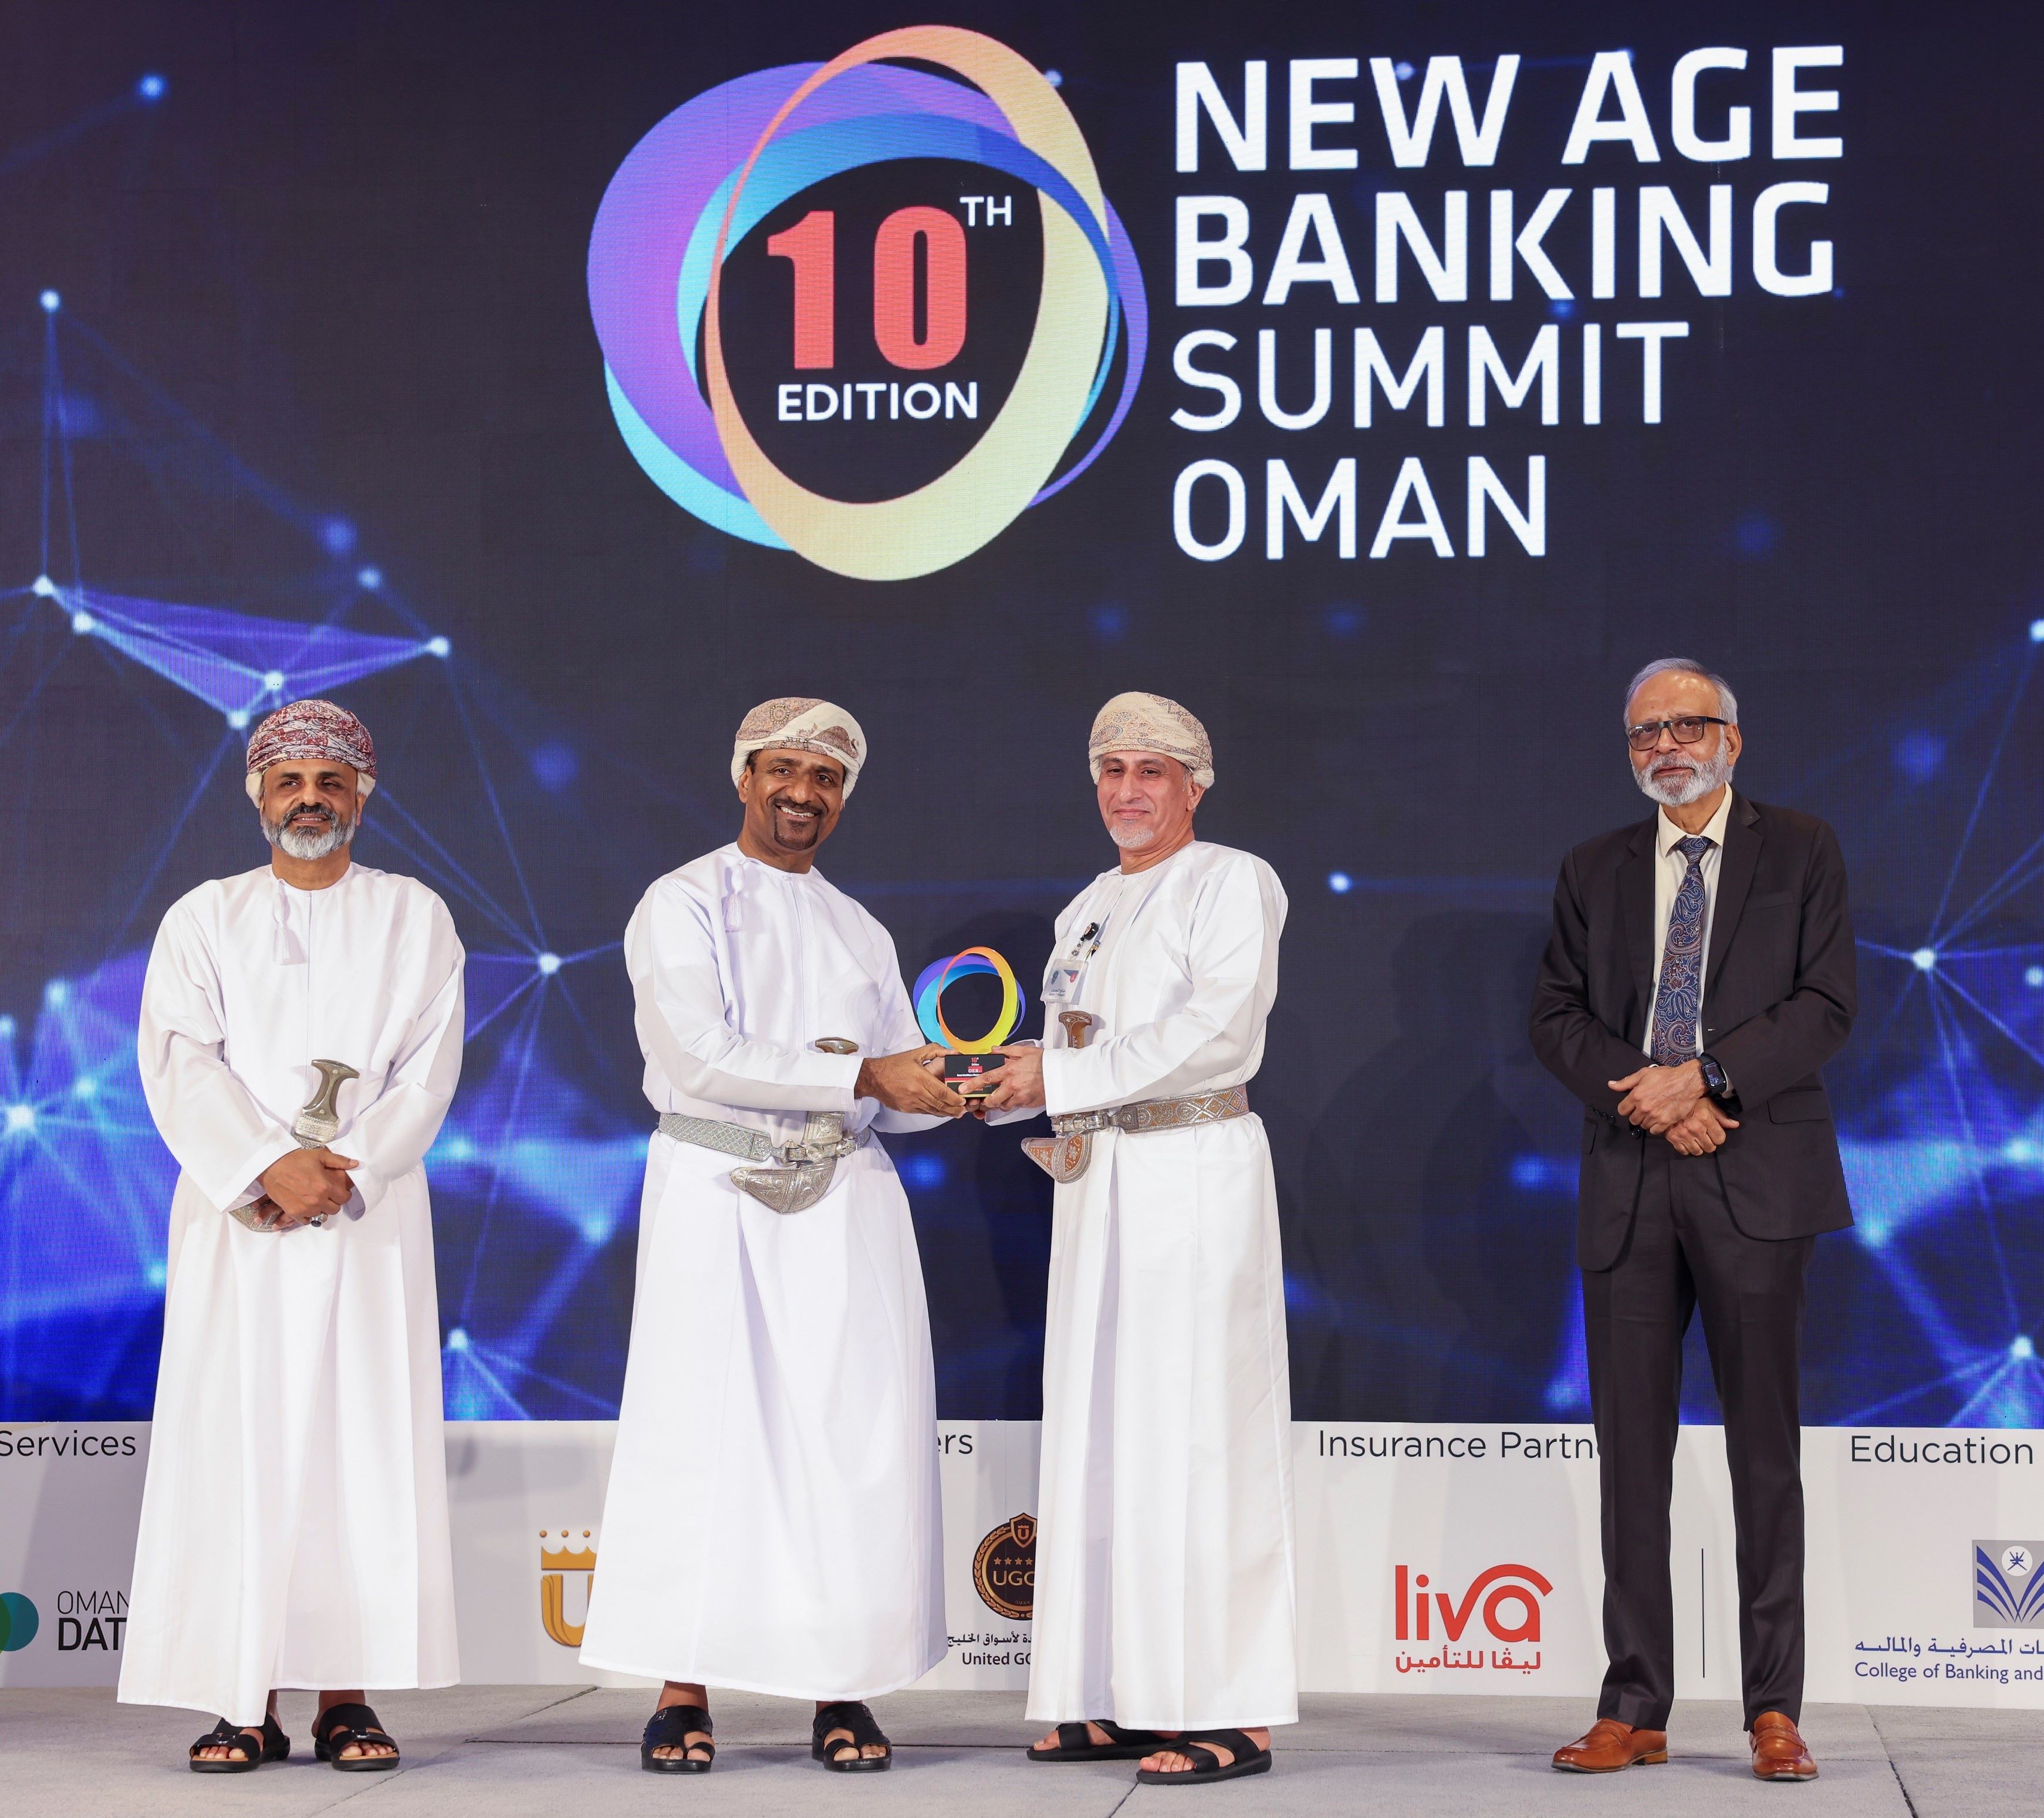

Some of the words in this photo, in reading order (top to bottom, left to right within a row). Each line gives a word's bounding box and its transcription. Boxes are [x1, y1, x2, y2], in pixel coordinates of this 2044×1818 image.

[1175, 54, 1521, 173] NEW
[1561, 45, 1844, 164] AGE
[1175, 181, 1833, 306] BANKING
[1171, 322, 1689, 431] SUMMIT
[778, 381, 978, 421] EDITION
[1173, 455, 1546, 561] OMAN
[0, 1430, 136, 1457] Services
[1320, 1430, 1486, 1458] Insurance
[1501, 1431, 1600, 1459] Partn
[1852, 1435, 2033, 1464] Education
[993, 1570, 1035, 1586] UGC
[1396, 1564, 1553, 1643] liva
[58, 1617, 127, 1651] DAT
[983, 1631, 1020, 1646] لأسواق
[1927, 1638, 2012, 1658] المصرفية
[962, 1651, 1010, 1665] United
[1014, 1652, 1031, 1665] GC
[1396, 1644, 1484, 1673] للتأمين
[1854, 1661, 1917, 1682] College
[1923, 1663, 1940, 1678] of
[1945, 1664, 2009, 1684] Banking
[2014, 1665, 2043, 1680] and
